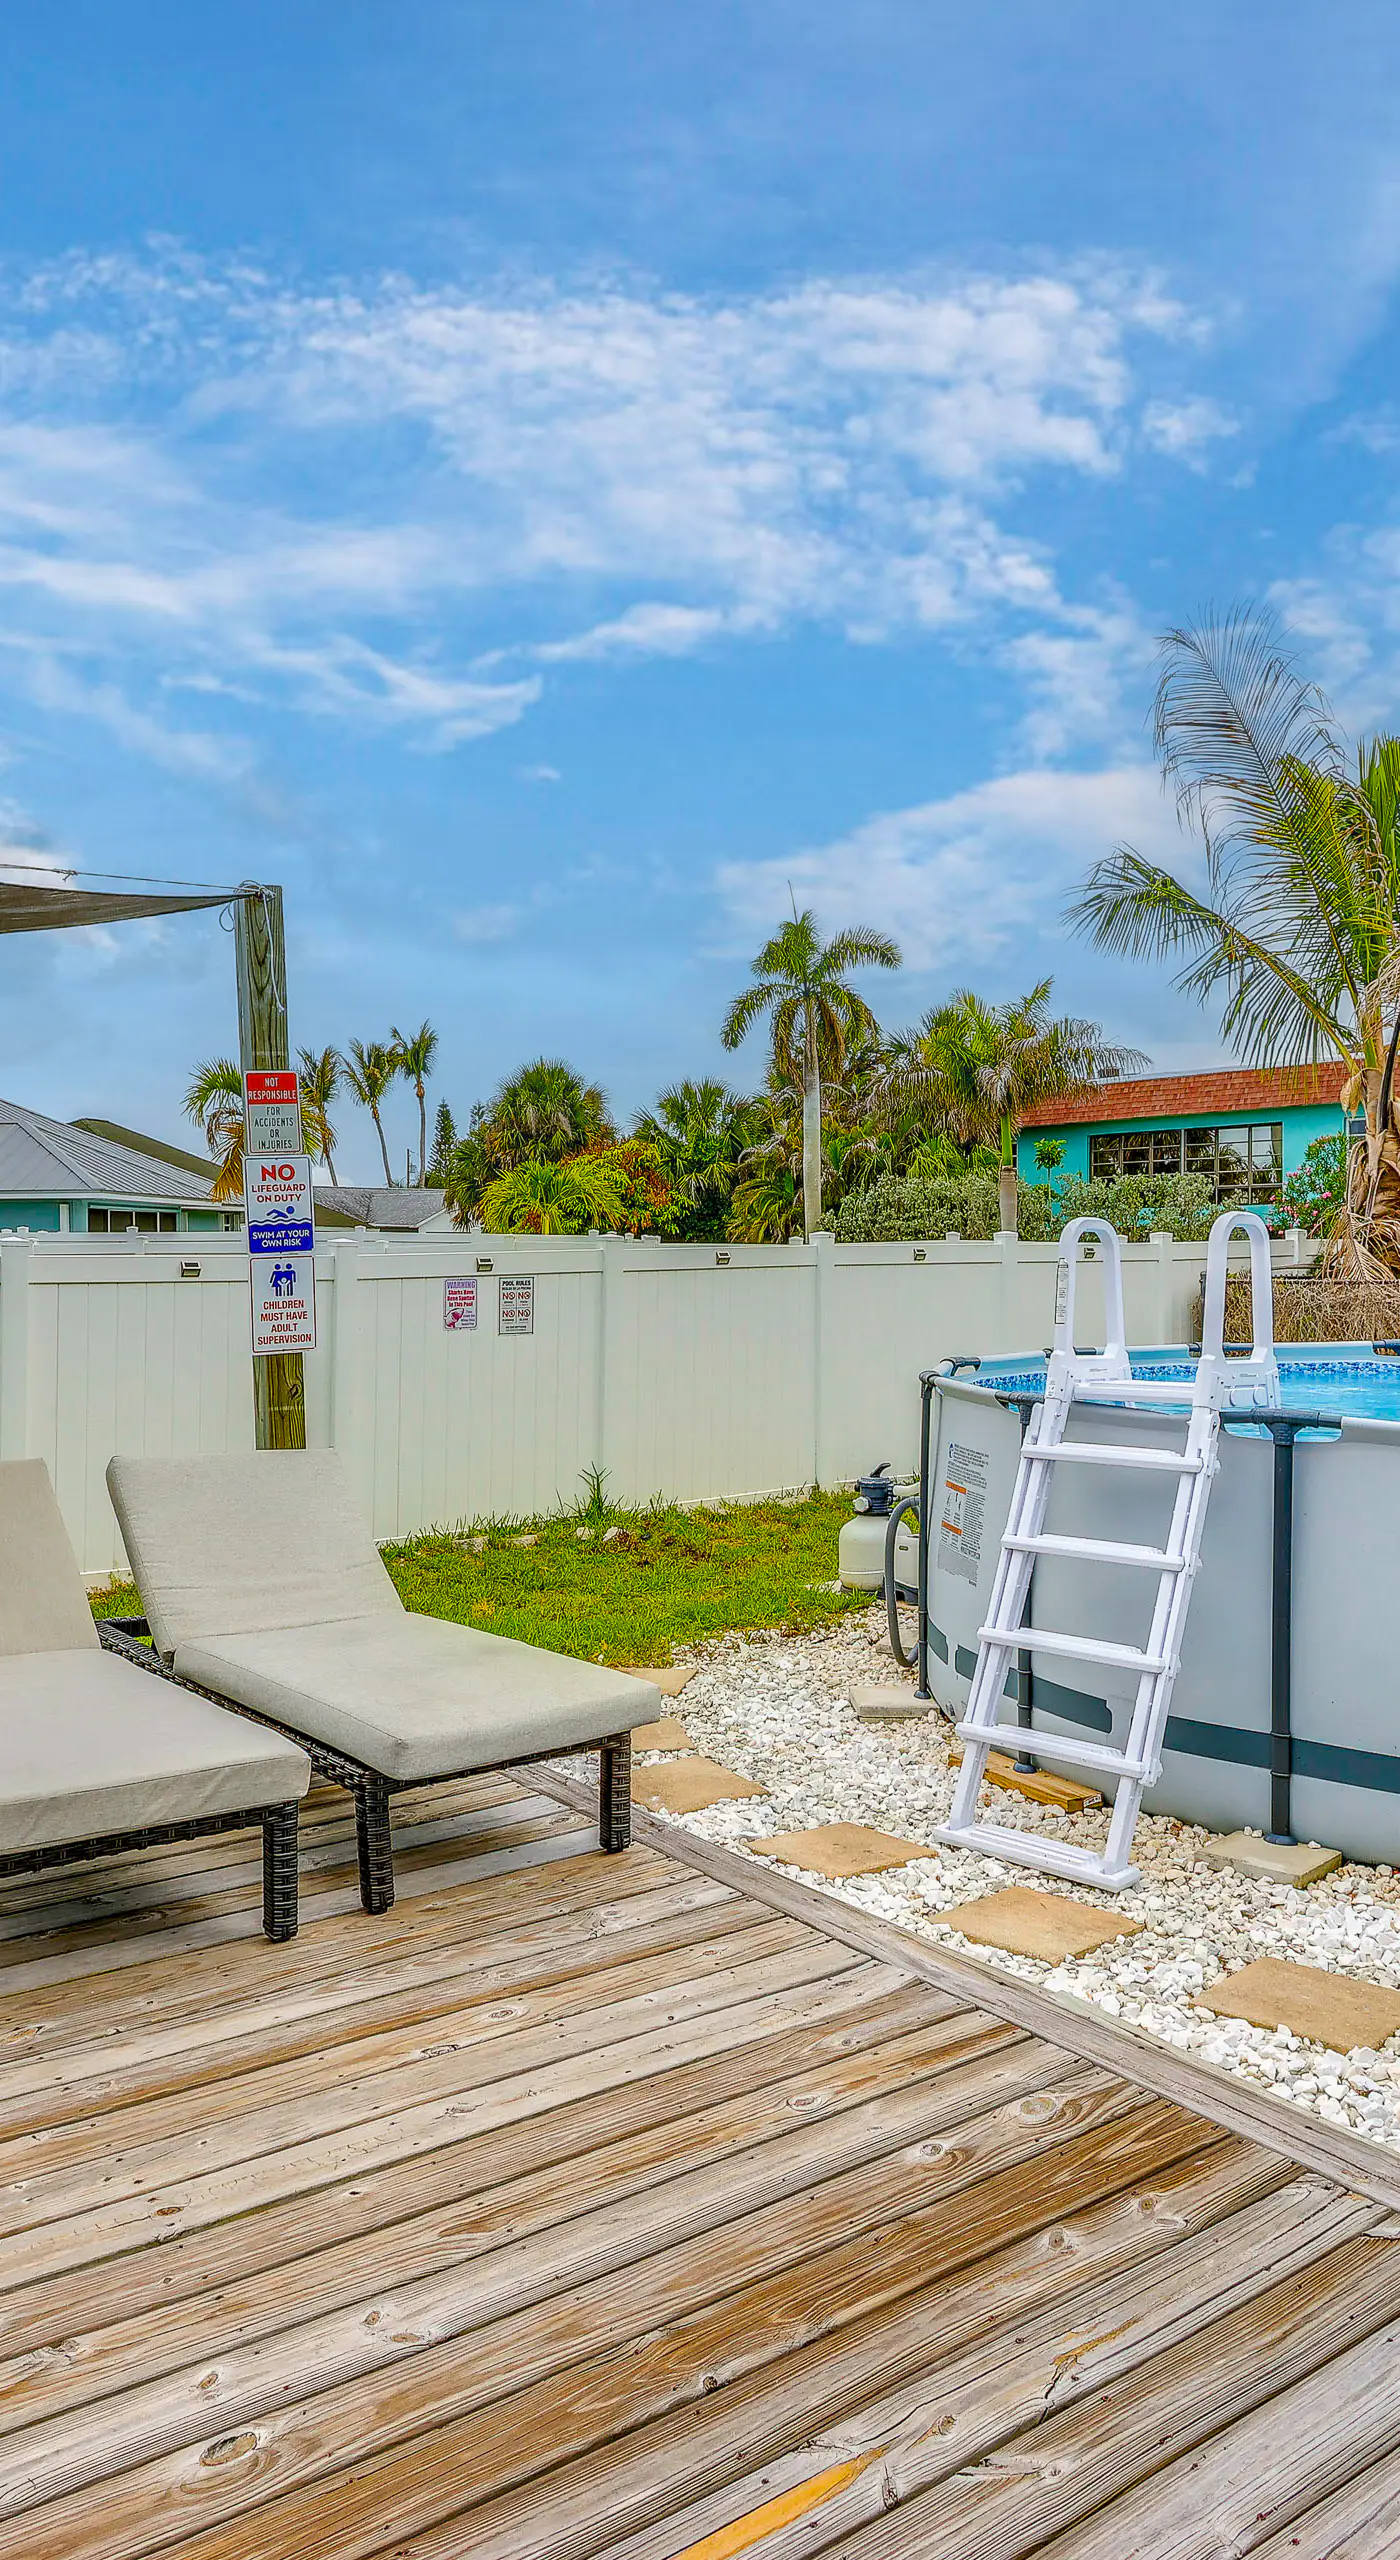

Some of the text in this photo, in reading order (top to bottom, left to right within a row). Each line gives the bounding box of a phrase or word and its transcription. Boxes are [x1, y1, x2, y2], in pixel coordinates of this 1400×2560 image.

[264, 1077, 279, 1087] NOT
[248, 1090, 297, 1100] RESPONSIBLE
[266, 1106, 280, 1115] FOR
[254, 1118, 294, 1127] ACCIDENTS
[269, 1129, 280, 1138] OR
[258, 1140, 293, 1150] INJURIES
[261, 1164, 295, 1181] NO
[251, 1183, 306, 1193] LIFEGUARD
[256, 1194, 302, 1203] ON DUTY
[252, 1229, 310, 1240] SWIM AT YOUR
[261, 1238, 302, 1248] OWN RISK
[447, 1281, 475, 1289] WARNING
[263, 1299, 304, 1310] CHILDREN
[260, 1311, 308, 1322] MUST HAVE
[271, 1323, 298, 1333] ADULT
[257, 1333, 312, 1345] SUPERVISION
